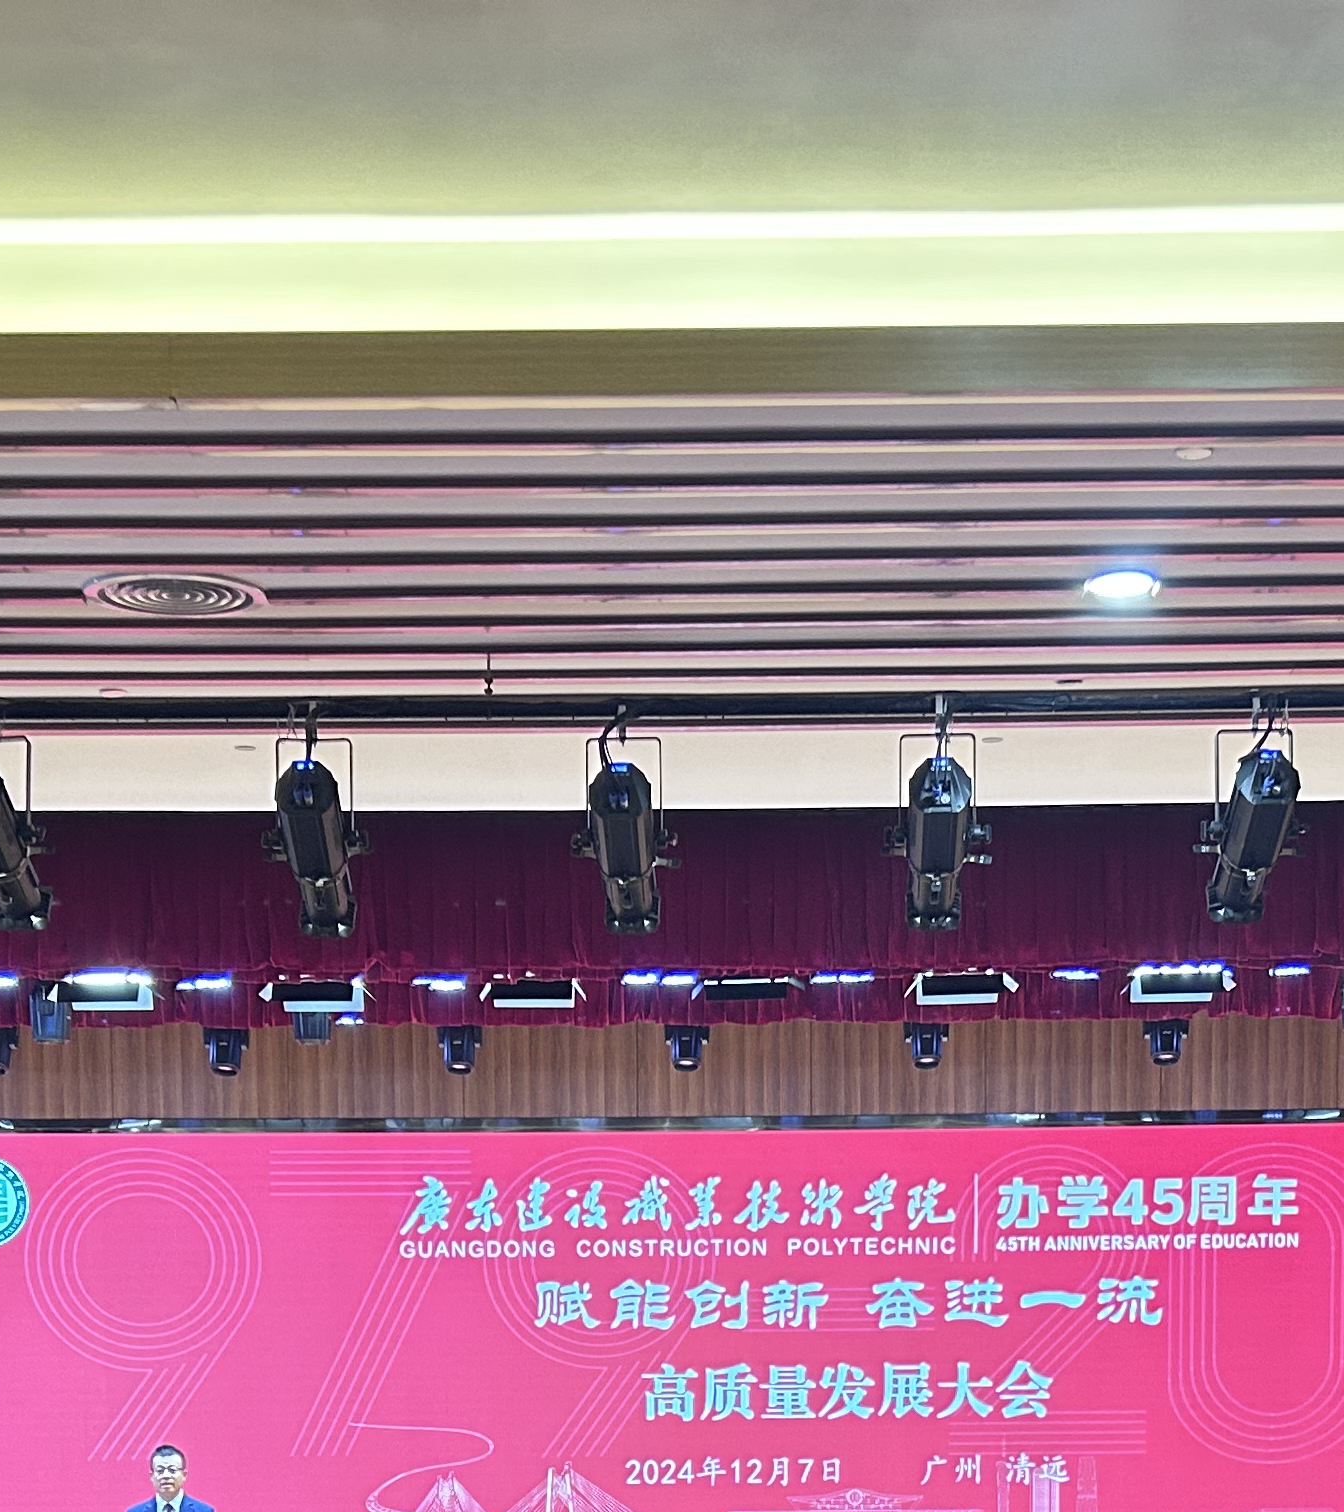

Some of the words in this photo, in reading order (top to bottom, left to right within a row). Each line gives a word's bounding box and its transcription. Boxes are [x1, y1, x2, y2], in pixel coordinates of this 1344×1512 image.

[996, 1173, 1300, 1230] 办学45周年
[399, 1239, 556, 1259] GUANGDONG
[576, 1238, 768, 1258] CONSTRUCTION
[786, 1236, 956, 1256] POLYTECHNIC
[996, 1235, 1040, 1252] 45TH
[1043, 1233, 1171, 1251] ANNIVERSARY
[1173, 1233, 1197, 1250] OF
[1200, 1231, 1300, 1250] EDUCATION
[534, 1278, 830, 1331] 赋能创新
[864, 1275, 1164, 1328] 奋进一流
[640, 1360, 1054, 1422] 高质量发展大会
[624, 1454, 842, 1488] 2024年12月7日
[919, 1454, 983, 1485] 广州
[1004, 1452, 1072, 1487] 清远
